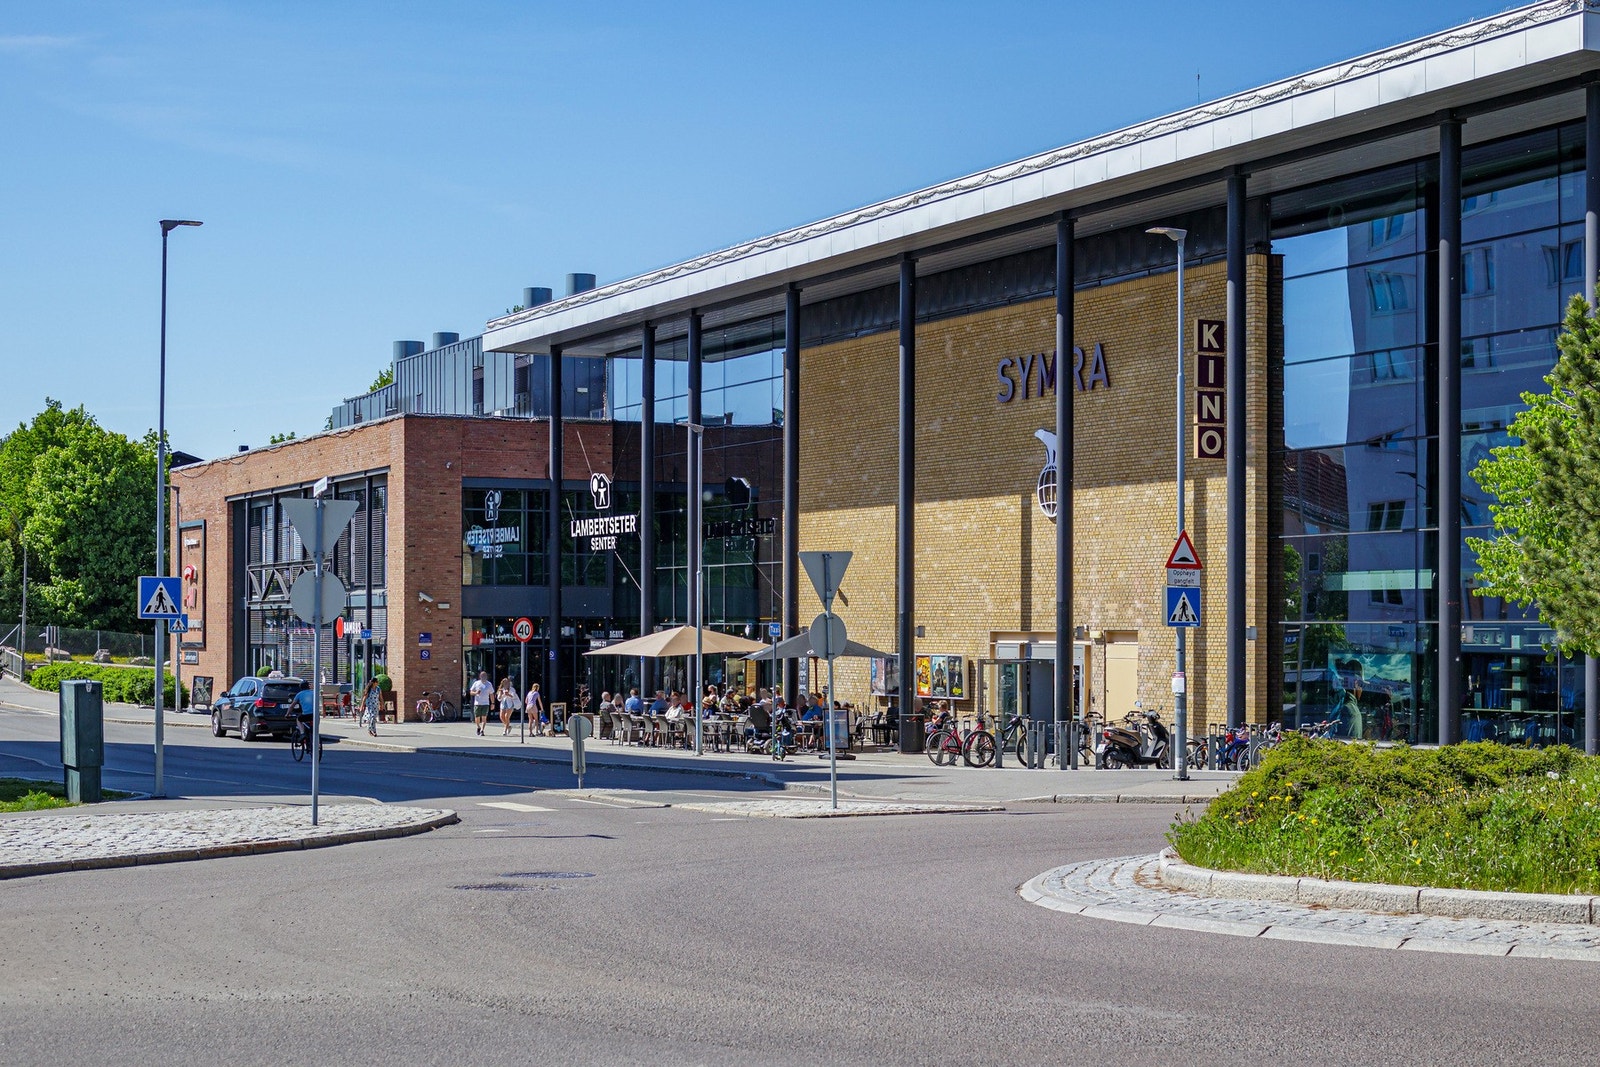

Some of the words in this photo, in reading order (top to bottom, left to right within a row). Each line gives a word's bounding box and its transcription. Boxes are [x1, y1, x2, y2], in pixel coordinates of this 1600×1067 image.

[996, 342, 1111, 404] SYMRA
[1200, 323, 1222, 455] KINO
[570, 514, 636, 538] LAMBERTSETER
[590, 536, 616, 551] SENTER
[517, 624, 530, 636] 40
